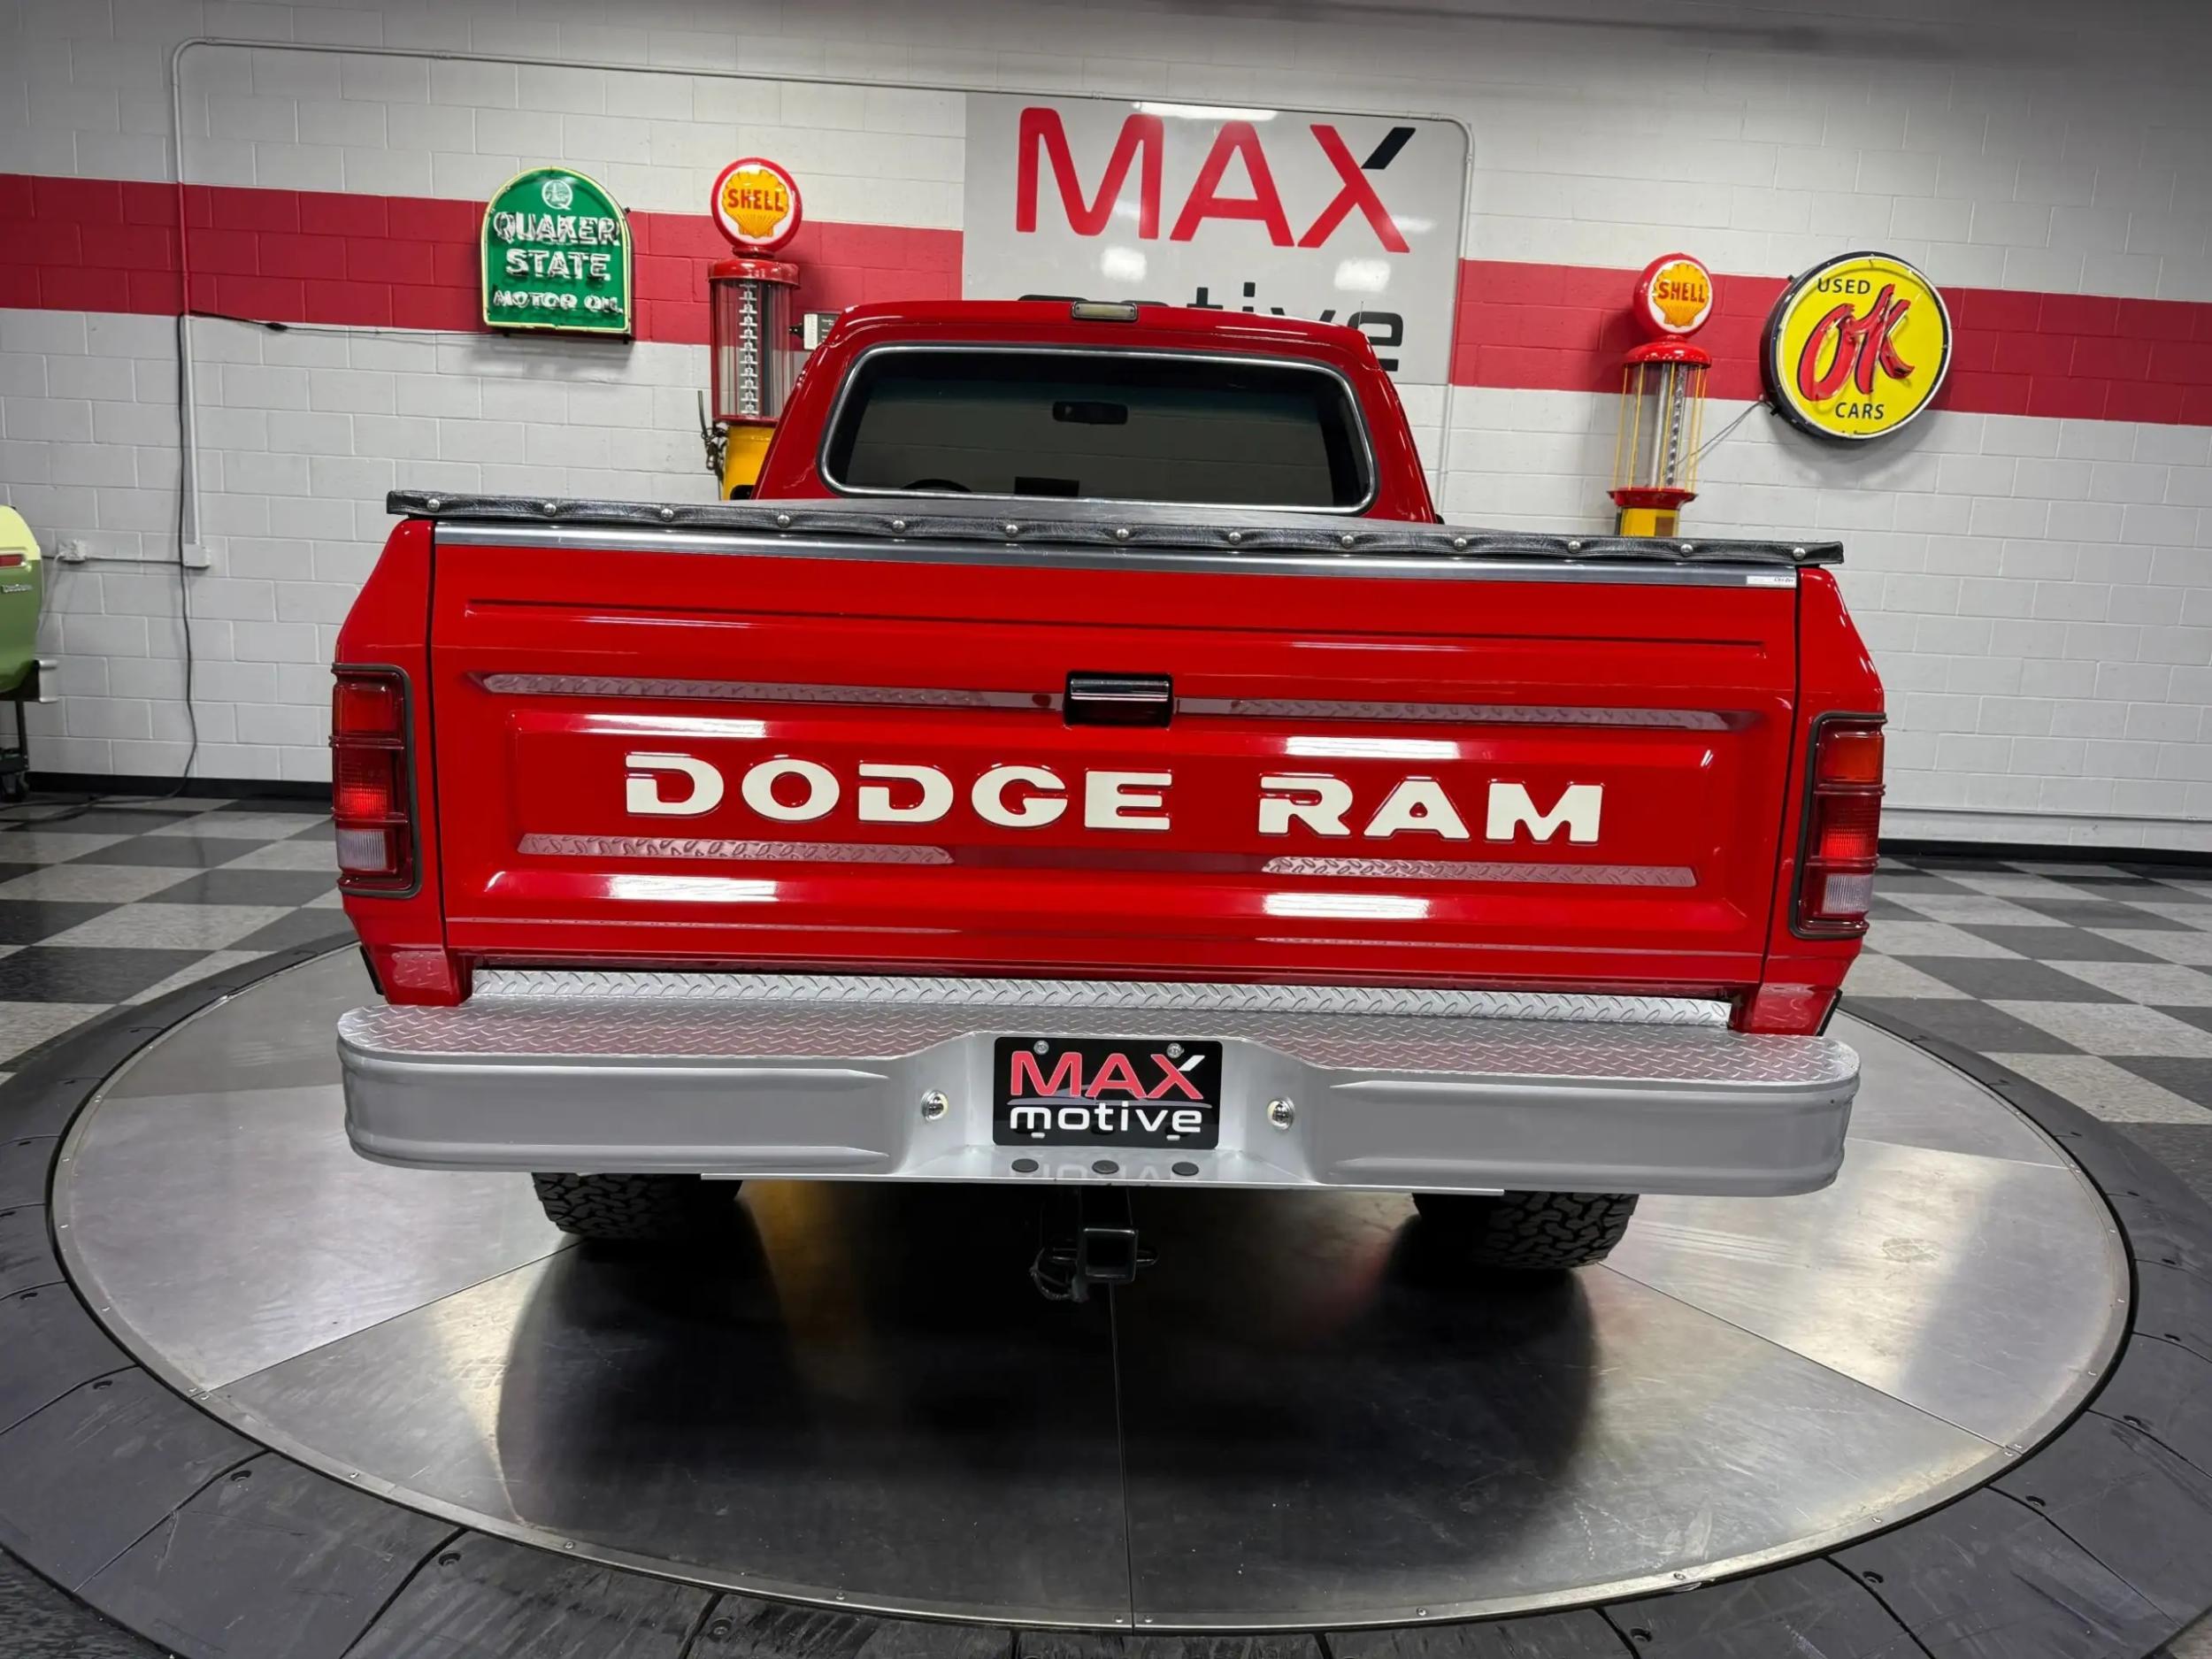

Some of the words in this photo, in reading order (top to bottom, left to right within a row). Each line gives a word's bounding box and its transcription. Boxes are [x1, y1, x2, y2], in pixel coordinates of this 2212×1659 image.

[1016, 107, 1416, 253] MAX
[727, 188, 784, 212] SHELL
[494, 212, 620, 246] QUAKER
[506, 249, 611, 280] STATE
[494, 290, 578, 310] MOTOR
[1657, 281, 1705, 303] SHELL
[1817, 278, 1870, 295] USED
[1835, 403, 1885, 419] CARS
[625, 754, 1172, 832] DODGE
[1258, 775, 1603, 843] RAM
[1010, 1050, 1205, 1100] MAX
[1010, 1101, 1202, 1133] motive
